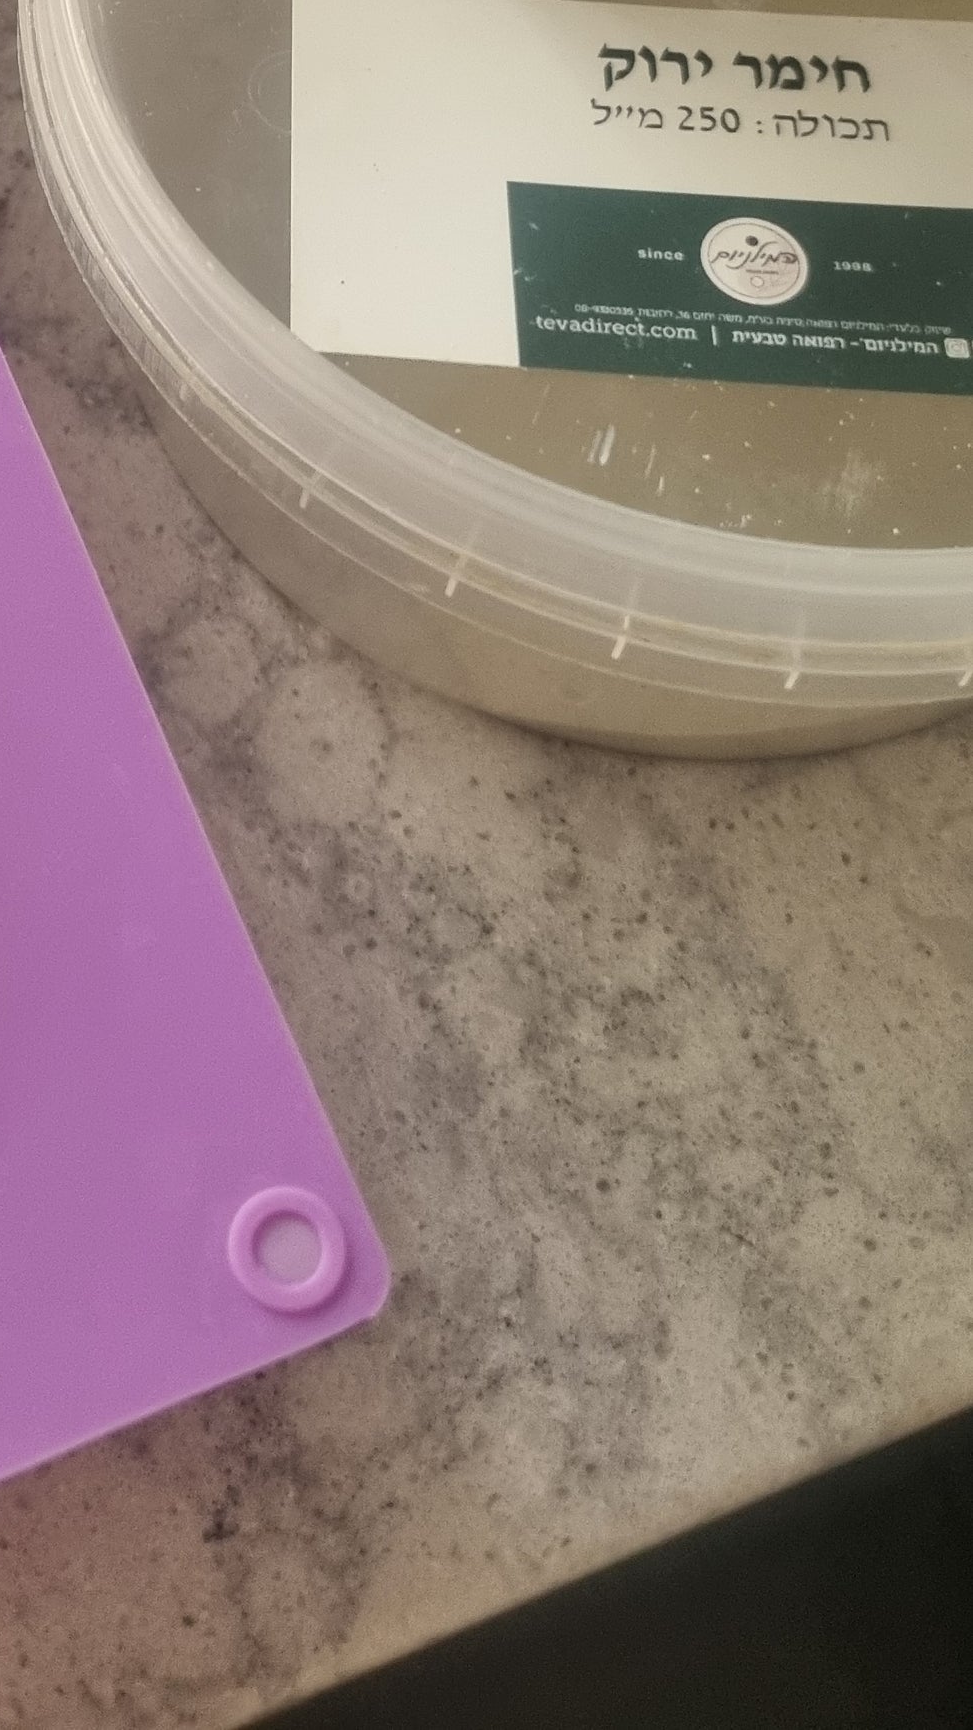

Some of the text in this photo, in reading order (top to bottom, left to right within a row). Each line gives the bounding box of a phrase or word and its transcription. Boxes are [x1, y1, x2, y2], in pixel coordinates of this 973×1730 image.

[597, 43, 872, 93] חימר ירוק
[677, 105, 742, 134] 250
[637, 247, 685, 262] since
[832, 259, 874, 273] 1998
[534, 314, 699, 341] tevadirect.com
[731, 329, 788, 346] טבעית
[792, 333, 846, 350] רפואה
